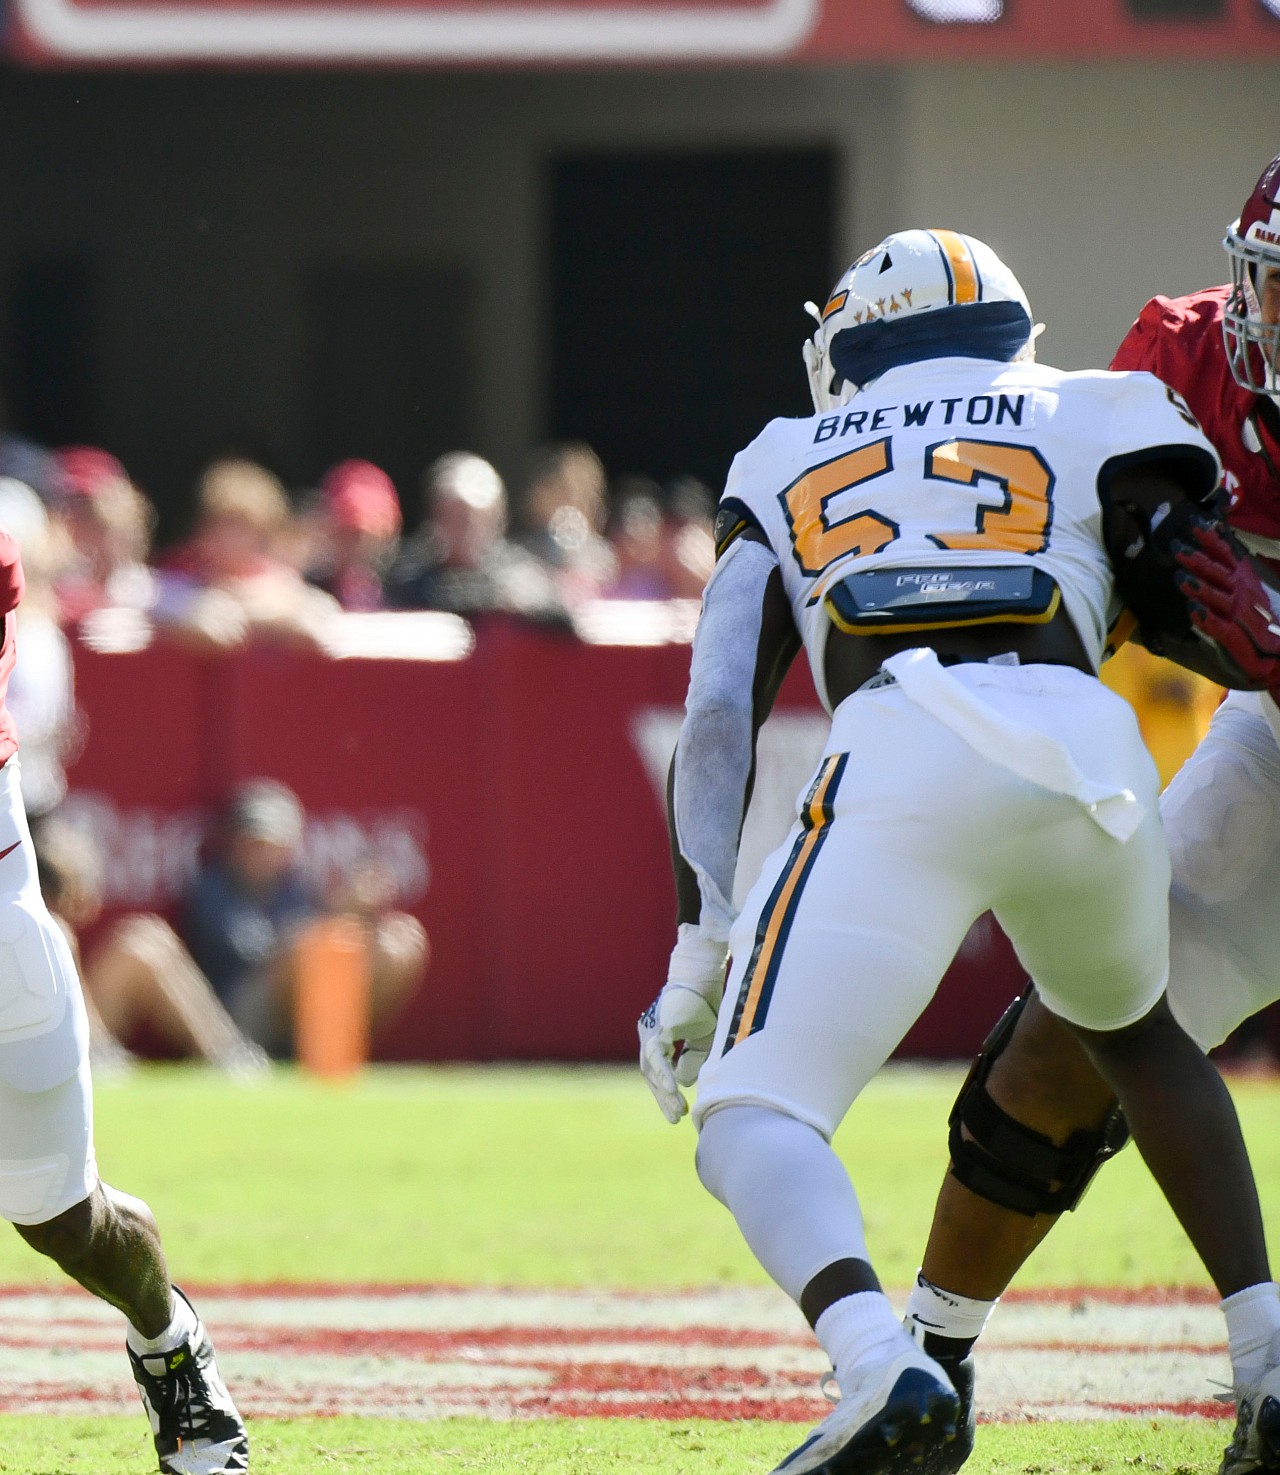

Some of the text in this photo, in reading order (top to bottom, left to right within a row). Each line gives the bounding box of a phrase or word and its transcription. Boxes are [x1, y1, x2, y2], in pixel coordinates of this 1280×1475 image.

[813, 394, 1025, 444] BREWTON
[777, 435, 1057, 580] 53
[895, 573, 954, 587] PRO
[920, 580, 996, 594] GEAR
